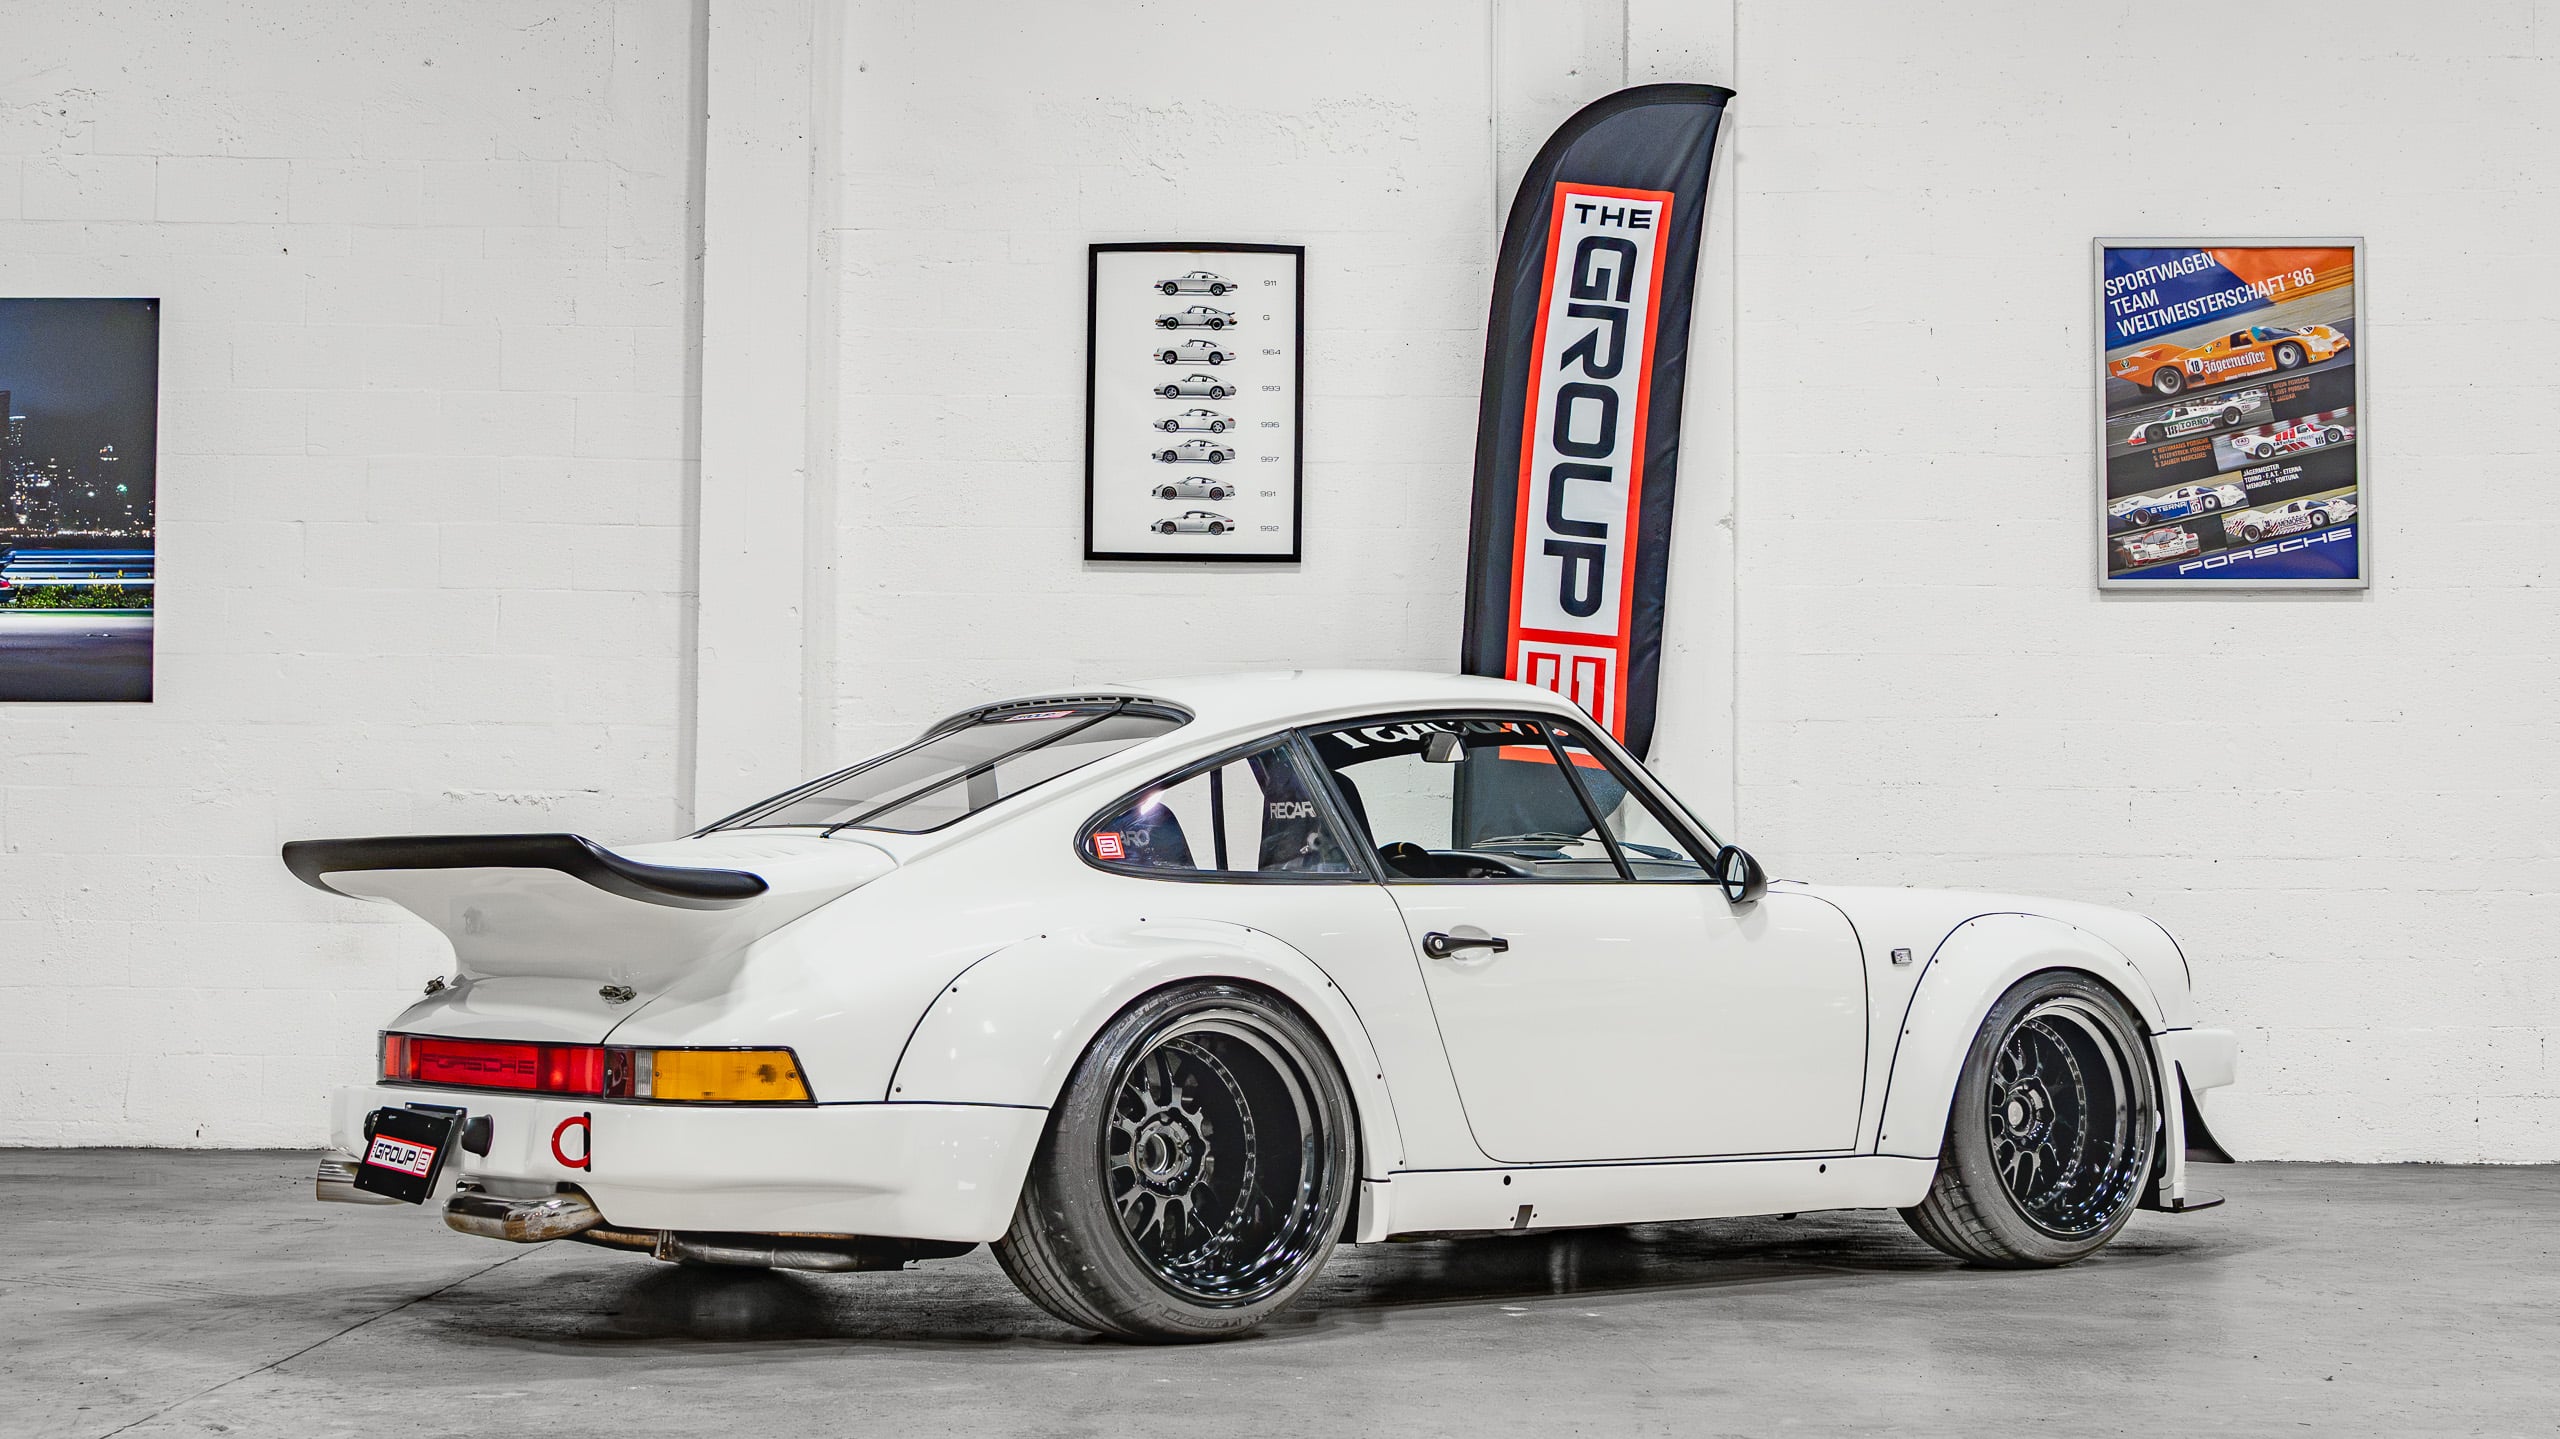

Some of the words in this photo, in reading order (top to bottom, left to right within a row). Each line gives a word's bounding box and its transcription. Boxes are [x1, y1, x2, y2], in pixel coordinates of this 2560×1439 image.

[1574, 203, 1653, 230] THE
[2105, 251, 2216, 297] SPORTWAGEN
[2110, 289, 2160, 317] TEAM
[2116, 274, 2285, 337] WELTMEISTERSCHAFT
[1262, 348, 1281, 356] 964
[2190, 360, 2200, 373] 18
[1543, 235, 1638, 618] GROUP
[2180, 417, 2209, 429] TORNO
[2283, 465, 2302, 475] ETERNA
[2150, 500, 2187, 514] ETERNA
[2179, 527, 2353, 575] PORSCHE
[1270, 801, 1318, 819] RECAR
[421, 1053, 536, 1075] PORSCHE
[374, 1143, 417, 1166] GROUP
